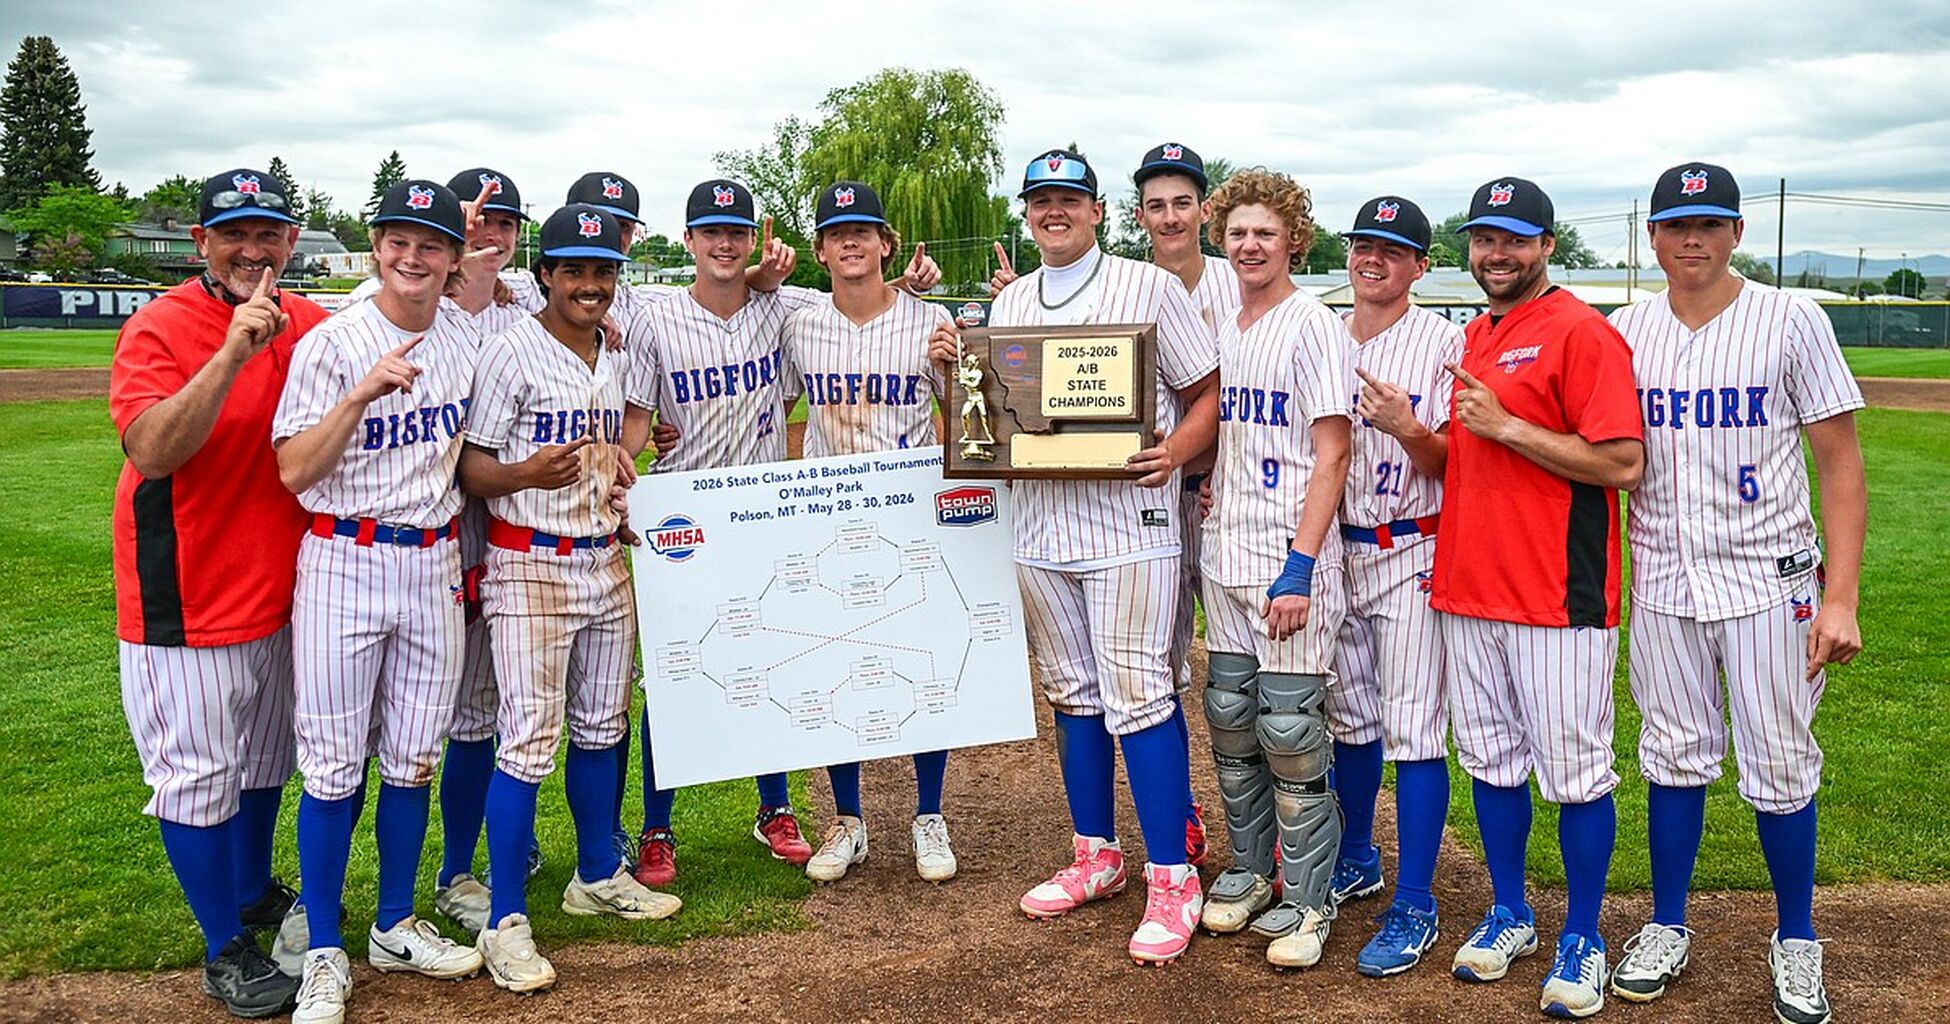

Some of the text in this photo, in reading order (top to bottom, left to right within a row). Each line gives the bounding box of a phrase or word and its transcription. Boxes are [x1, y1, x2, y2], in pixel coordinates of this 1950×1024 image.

[59, 290, 163, 315] PIR
[1057, 345, 1119, 358] 2025-2026
[1077, 363, 1099, 375] A/B
[1067, 379, 1107, 391] STATE
[1049, 396, 1125, 409] CHAMPIONS
[693, 456, 944, 491] 2026 State Class A-B Baseball Tournament
[1261, 457, 1280, 489] 9
[1375, 461, 1403, 497] 21
[779, 481, 864, 500] O'Malley Park
[1738, 464, 1760, 503] 5
[730, 509, 774, 523] Polson,
[777, 505, 797, 517] MT
[808, 501, 834, 516] May
[837, 499, 852, 511] 28
[863, 496, 882, 509] 30,
[885, 492, 915, 505] 2026
[941, 495, 991, 508] town
[943, 505, 992, 521] pump
[657, 528, 704, 548] MHSA
